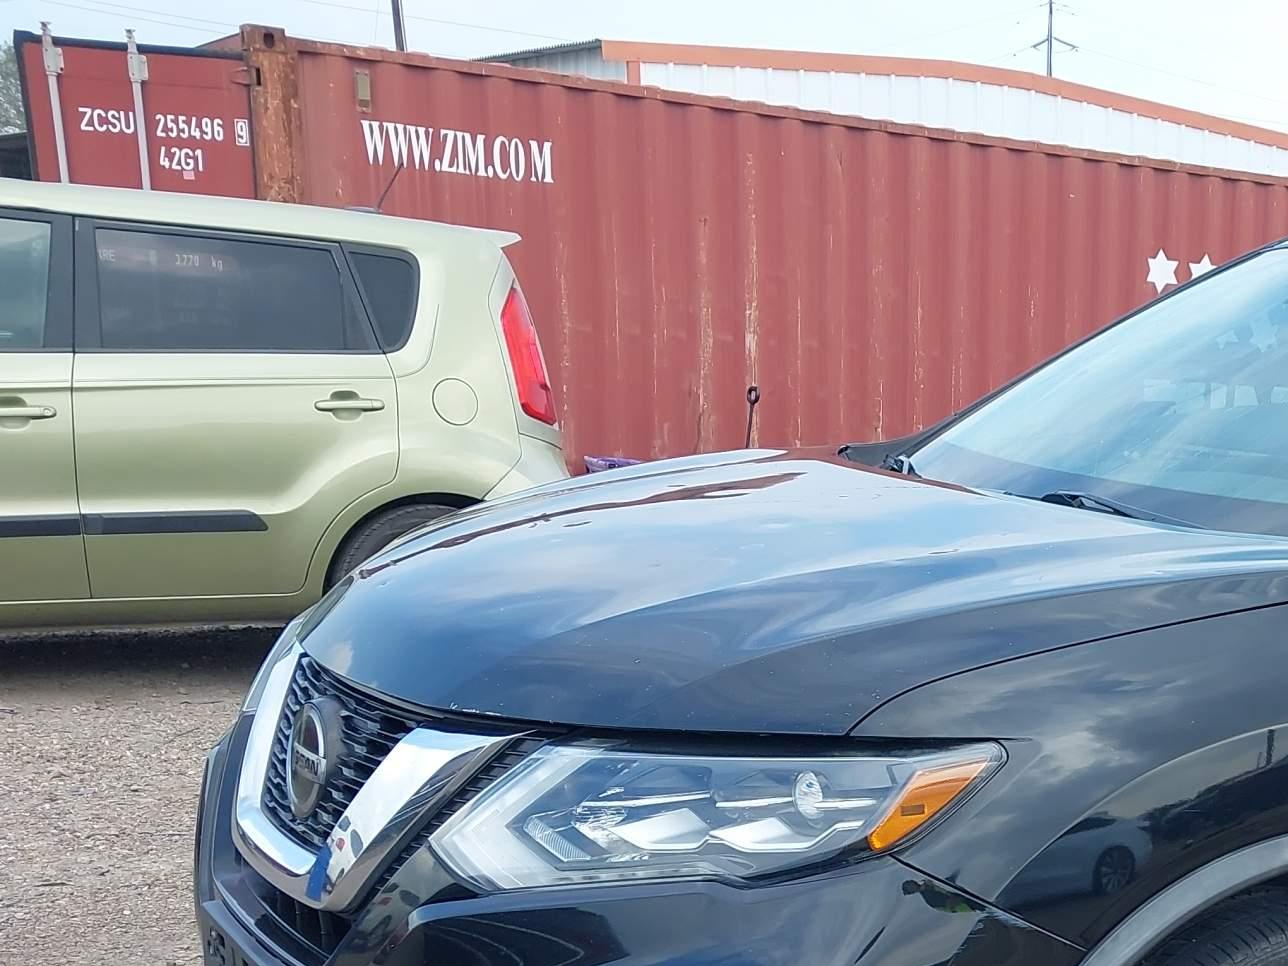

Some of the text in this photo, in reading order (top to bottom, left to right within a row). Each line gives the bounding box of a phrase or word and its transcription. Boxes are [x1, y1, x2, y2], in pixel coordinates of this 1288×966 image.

[78, 107, 134, 134] ZCSU
[155, 114, 223, 141] 255496
[160, 147, 203, 171] 42G1
